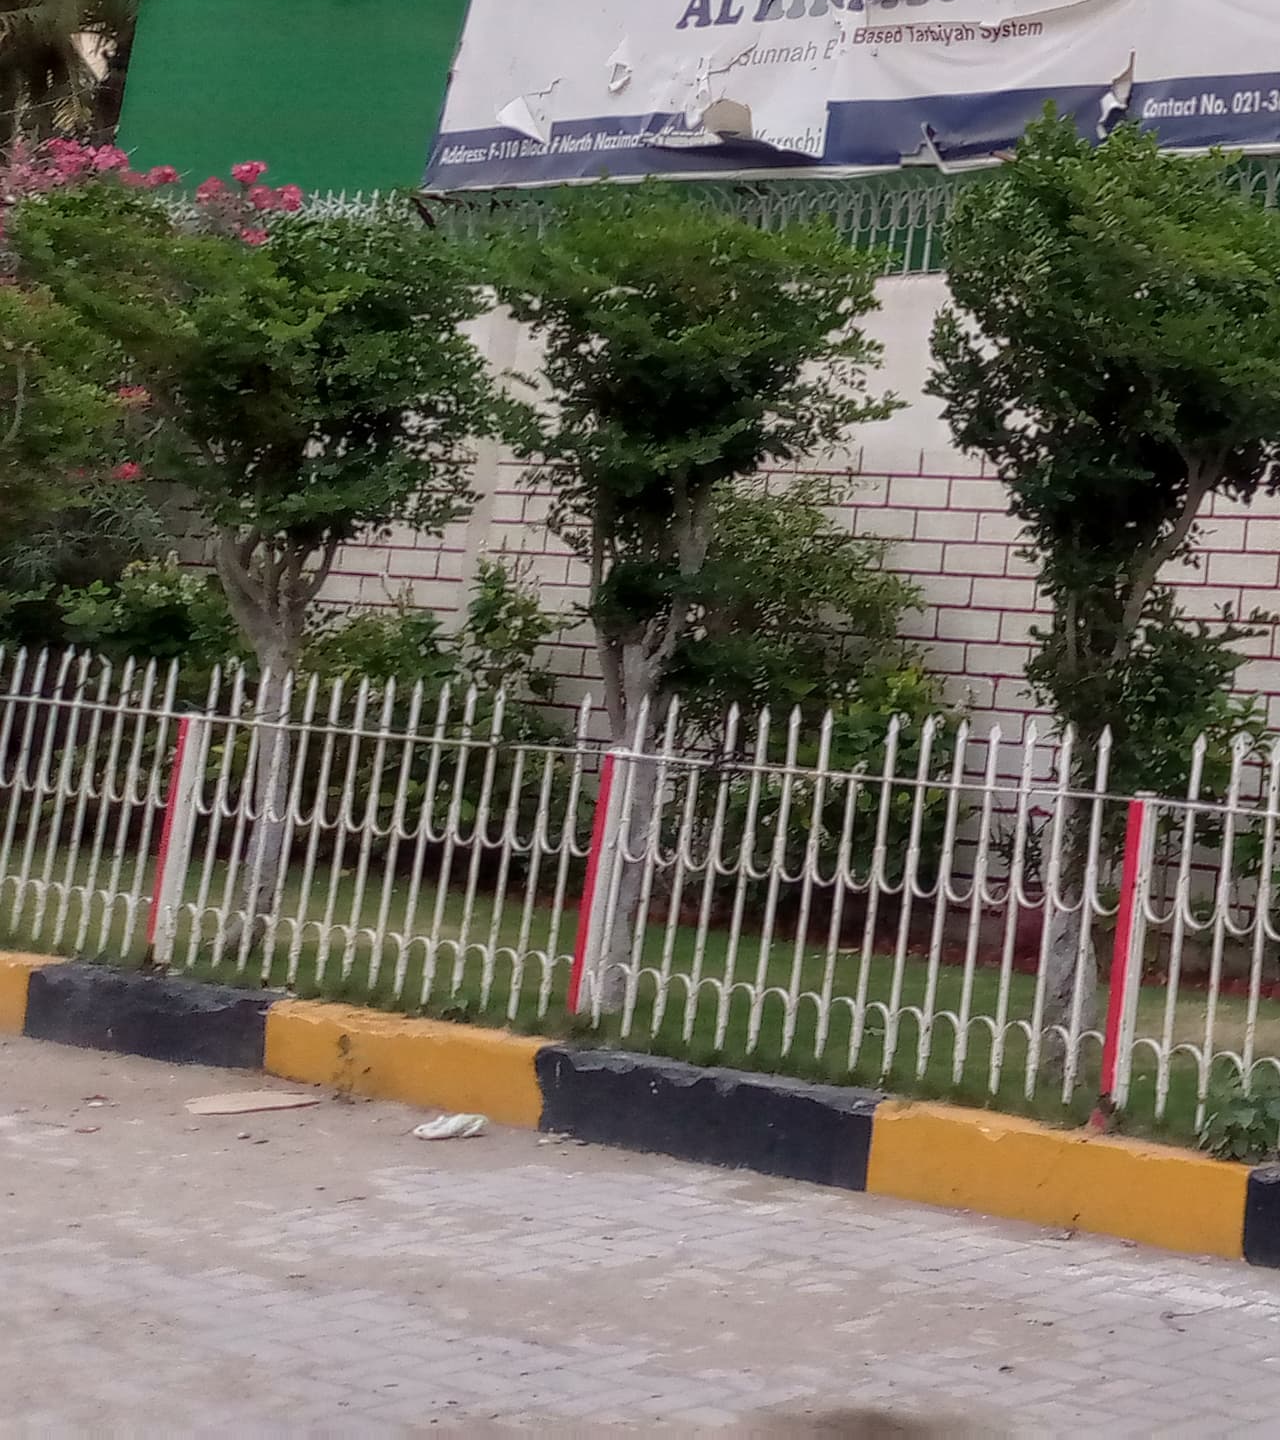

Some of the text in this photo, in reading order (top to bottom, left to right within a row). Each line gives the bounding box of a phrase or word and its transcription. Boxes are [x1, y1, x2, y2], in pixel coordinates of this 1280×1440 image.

[853, 26, 902, 45] Based
[1142, 97, 1197, 118] Contact
[1200, 93, 1228, 116] No.
[558, 131, 593, 155] North
